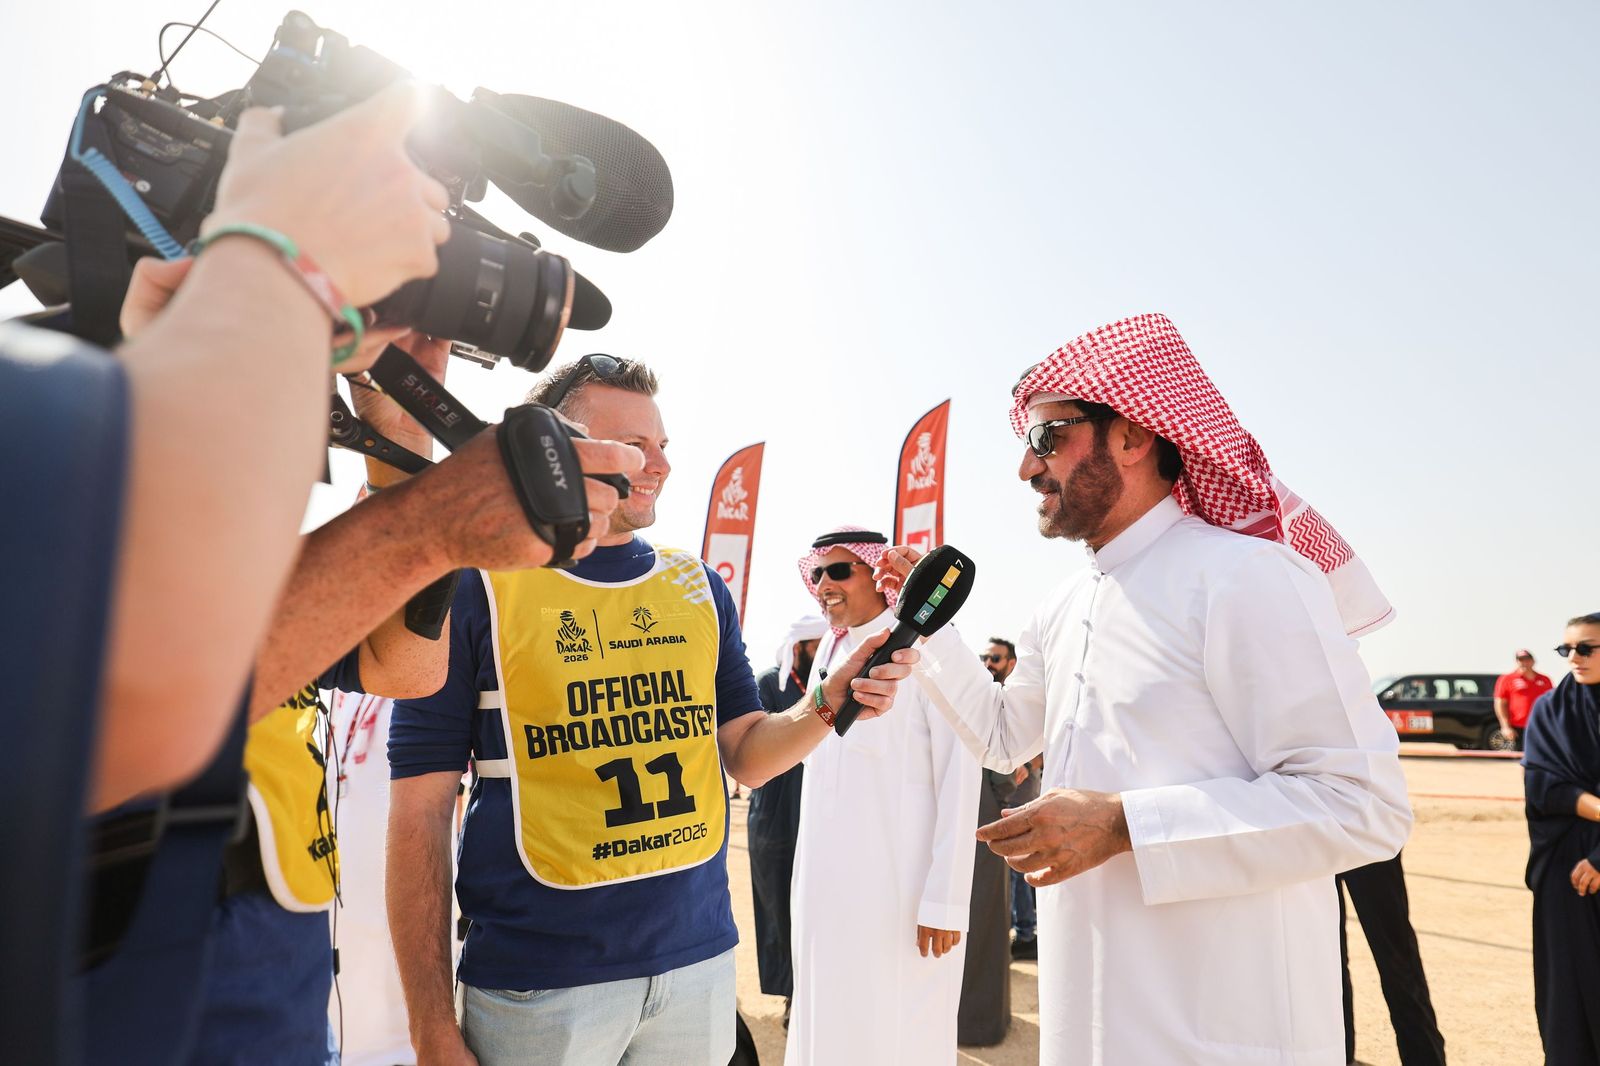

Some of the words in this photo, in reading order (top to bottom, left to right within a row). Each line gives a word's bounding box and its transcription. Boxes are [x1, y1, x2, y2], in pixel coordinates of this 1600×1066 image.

[540, 435, 568, 489] SONY
[555, 638, 593, 654] DAKAR
[564, 654, 589, 663] 2026
[608, 638, 643, 650] SAUDI
[645, 635, 687, 646] ARABIA
[566, 669, 693, 717] OFFICIAL
[524, 704, 714, 760] BROADCASTER
[594, 752, 697, 828] 11
[592, 822, 708, 860] #Dakar2026
